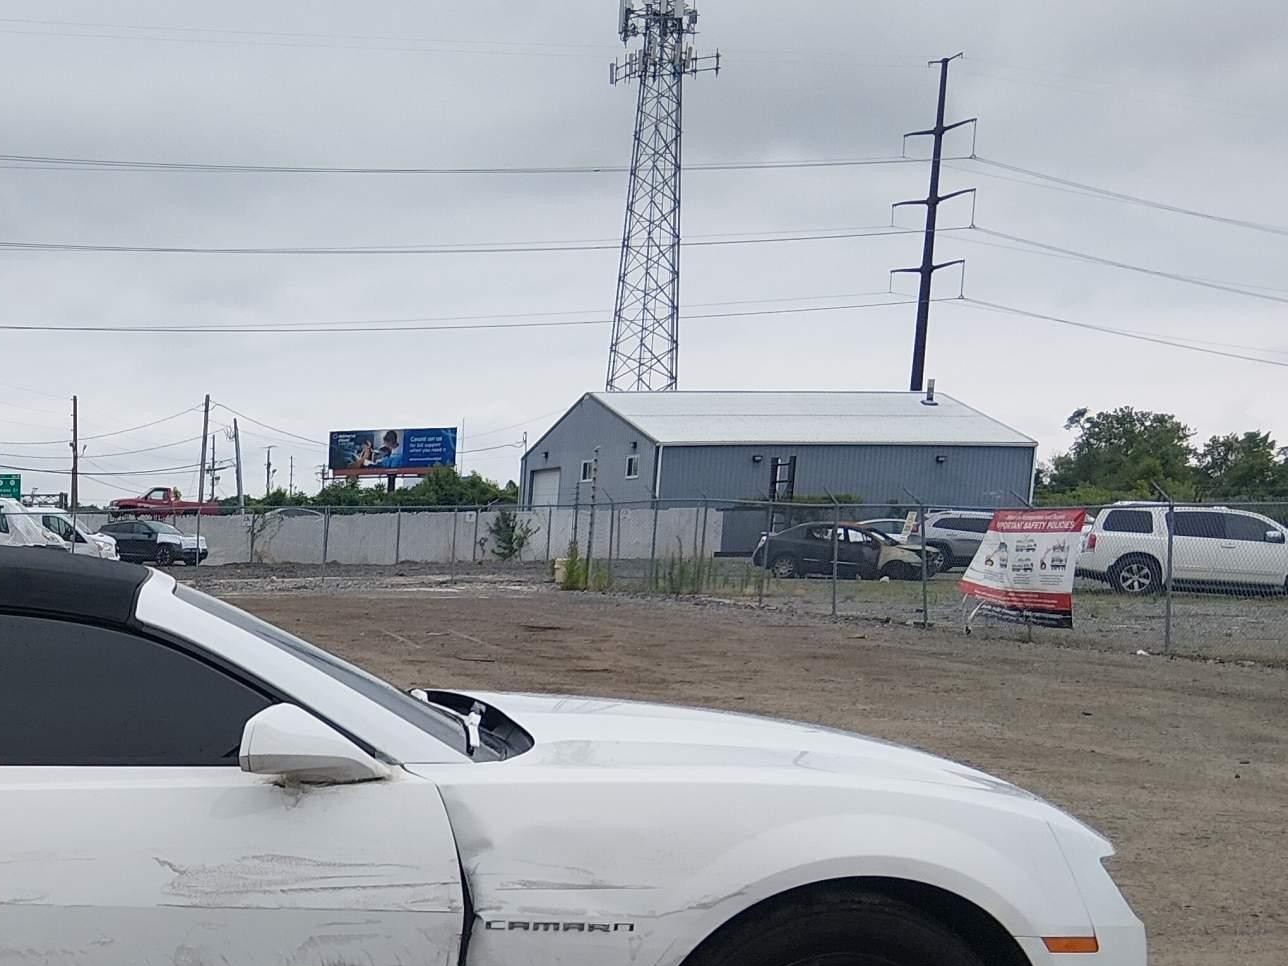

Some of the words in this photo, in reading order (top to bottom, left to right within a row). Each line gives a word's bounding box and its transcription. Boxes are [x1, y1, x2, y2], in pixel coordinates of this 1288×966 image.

[1023, 521, 1046, 529] SAFETY
[1046, 520, 1075, 529] POLICIES
[485, 920, 634, 932] CAMARO
